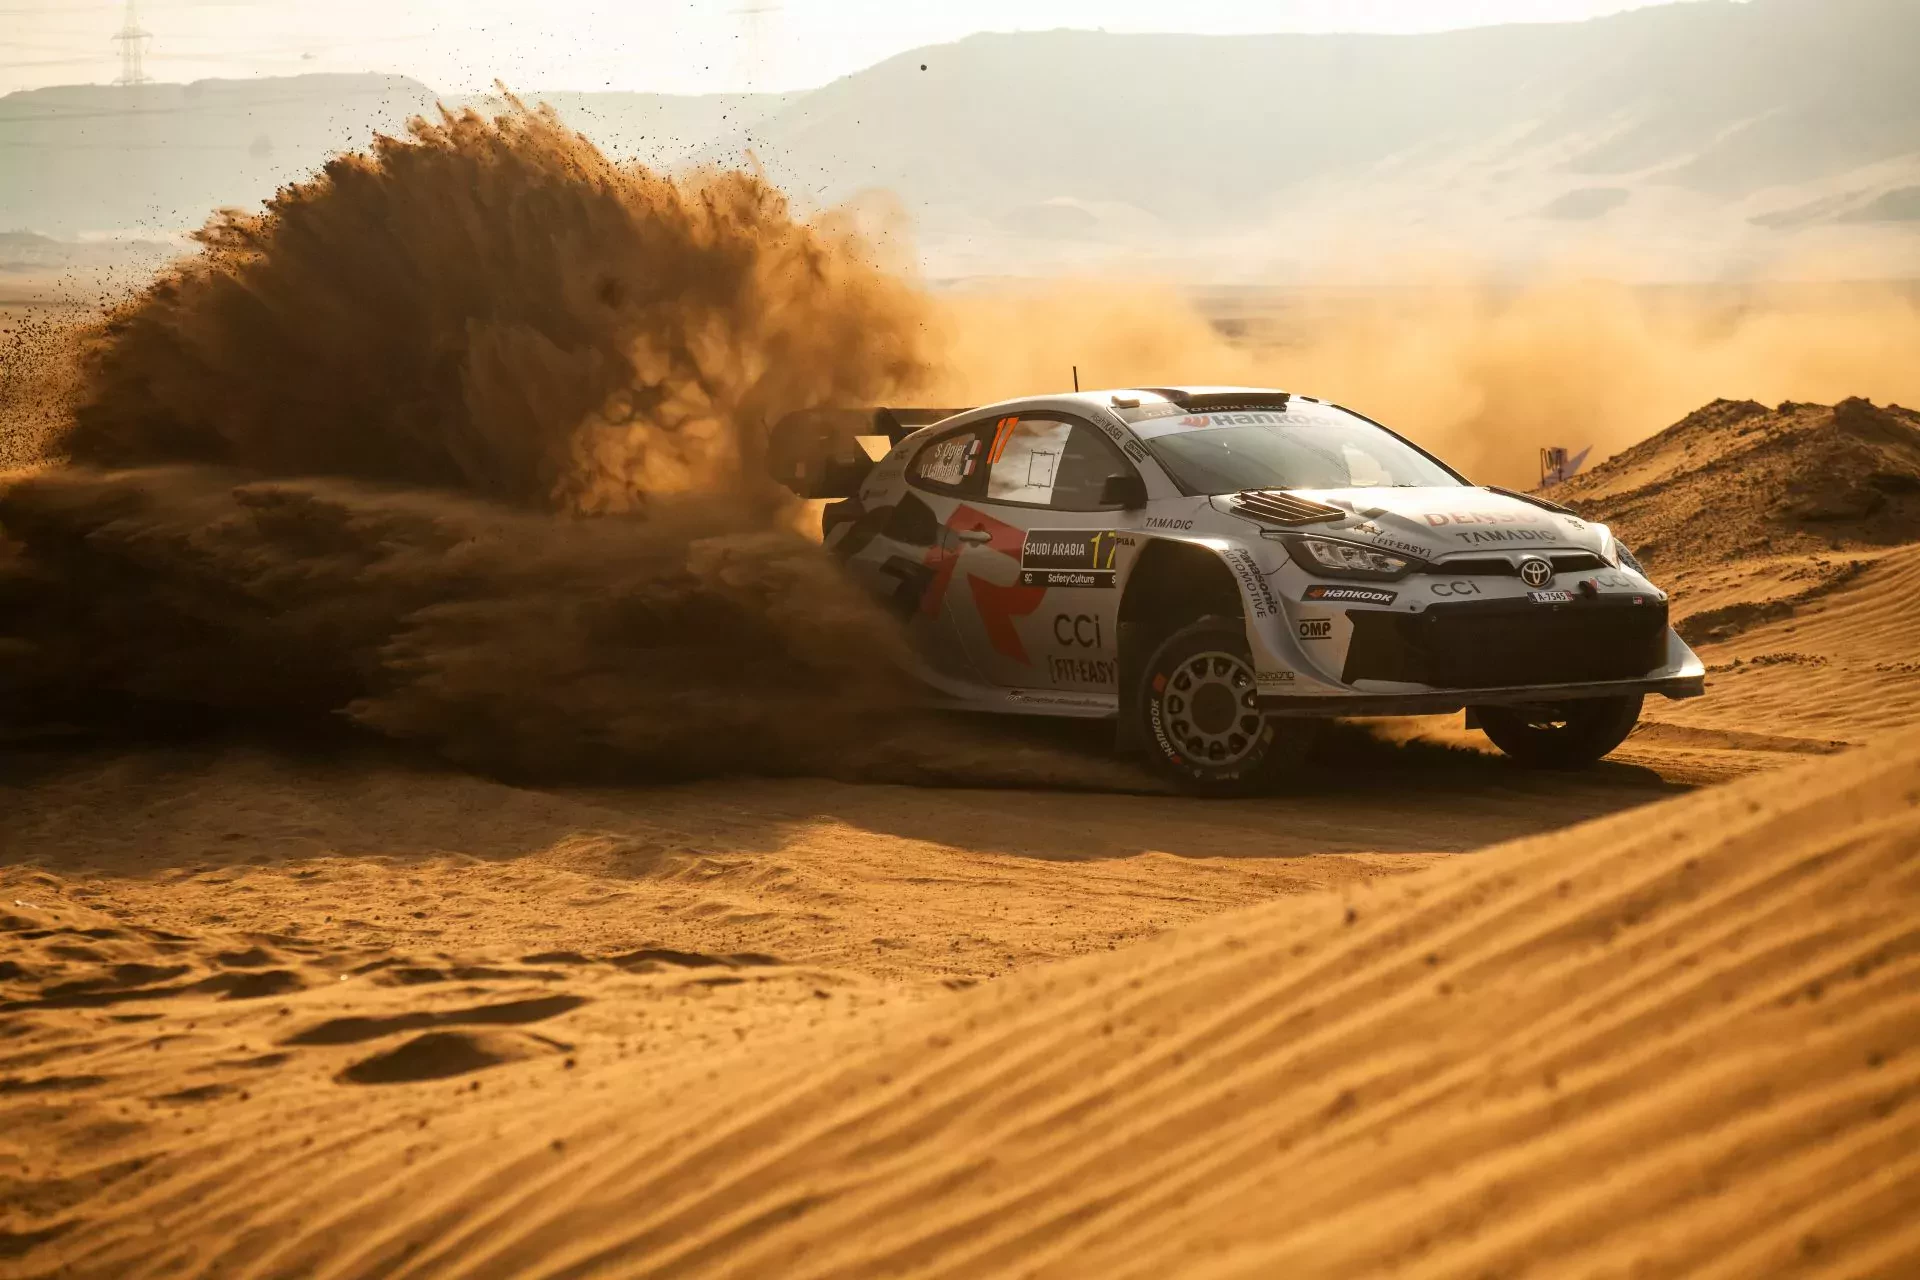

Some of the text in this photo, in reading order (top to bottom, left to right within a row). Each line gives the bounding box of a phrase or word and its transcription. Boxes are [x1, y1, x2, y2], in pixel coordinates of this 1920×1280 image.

[987, 416, 1019, 465] 17
[1145, 517, 1194, 530] TAMADIC
[1115, 537, 1136, 547] PIAA
[1455, 529, 1557, 545] TAMADIC
[1024, 542, 1086, 556] SAUDI ARABIA
[1090, 531, 1116, 569] 17
[1048, 572, 1095, 586] SafetyCulture
[1219, 549, 1267, 618] AUTOMOTIVE
[1233, 547, 1278, 615] Panasonic
[1299, 621, 1332, 637] OMP
